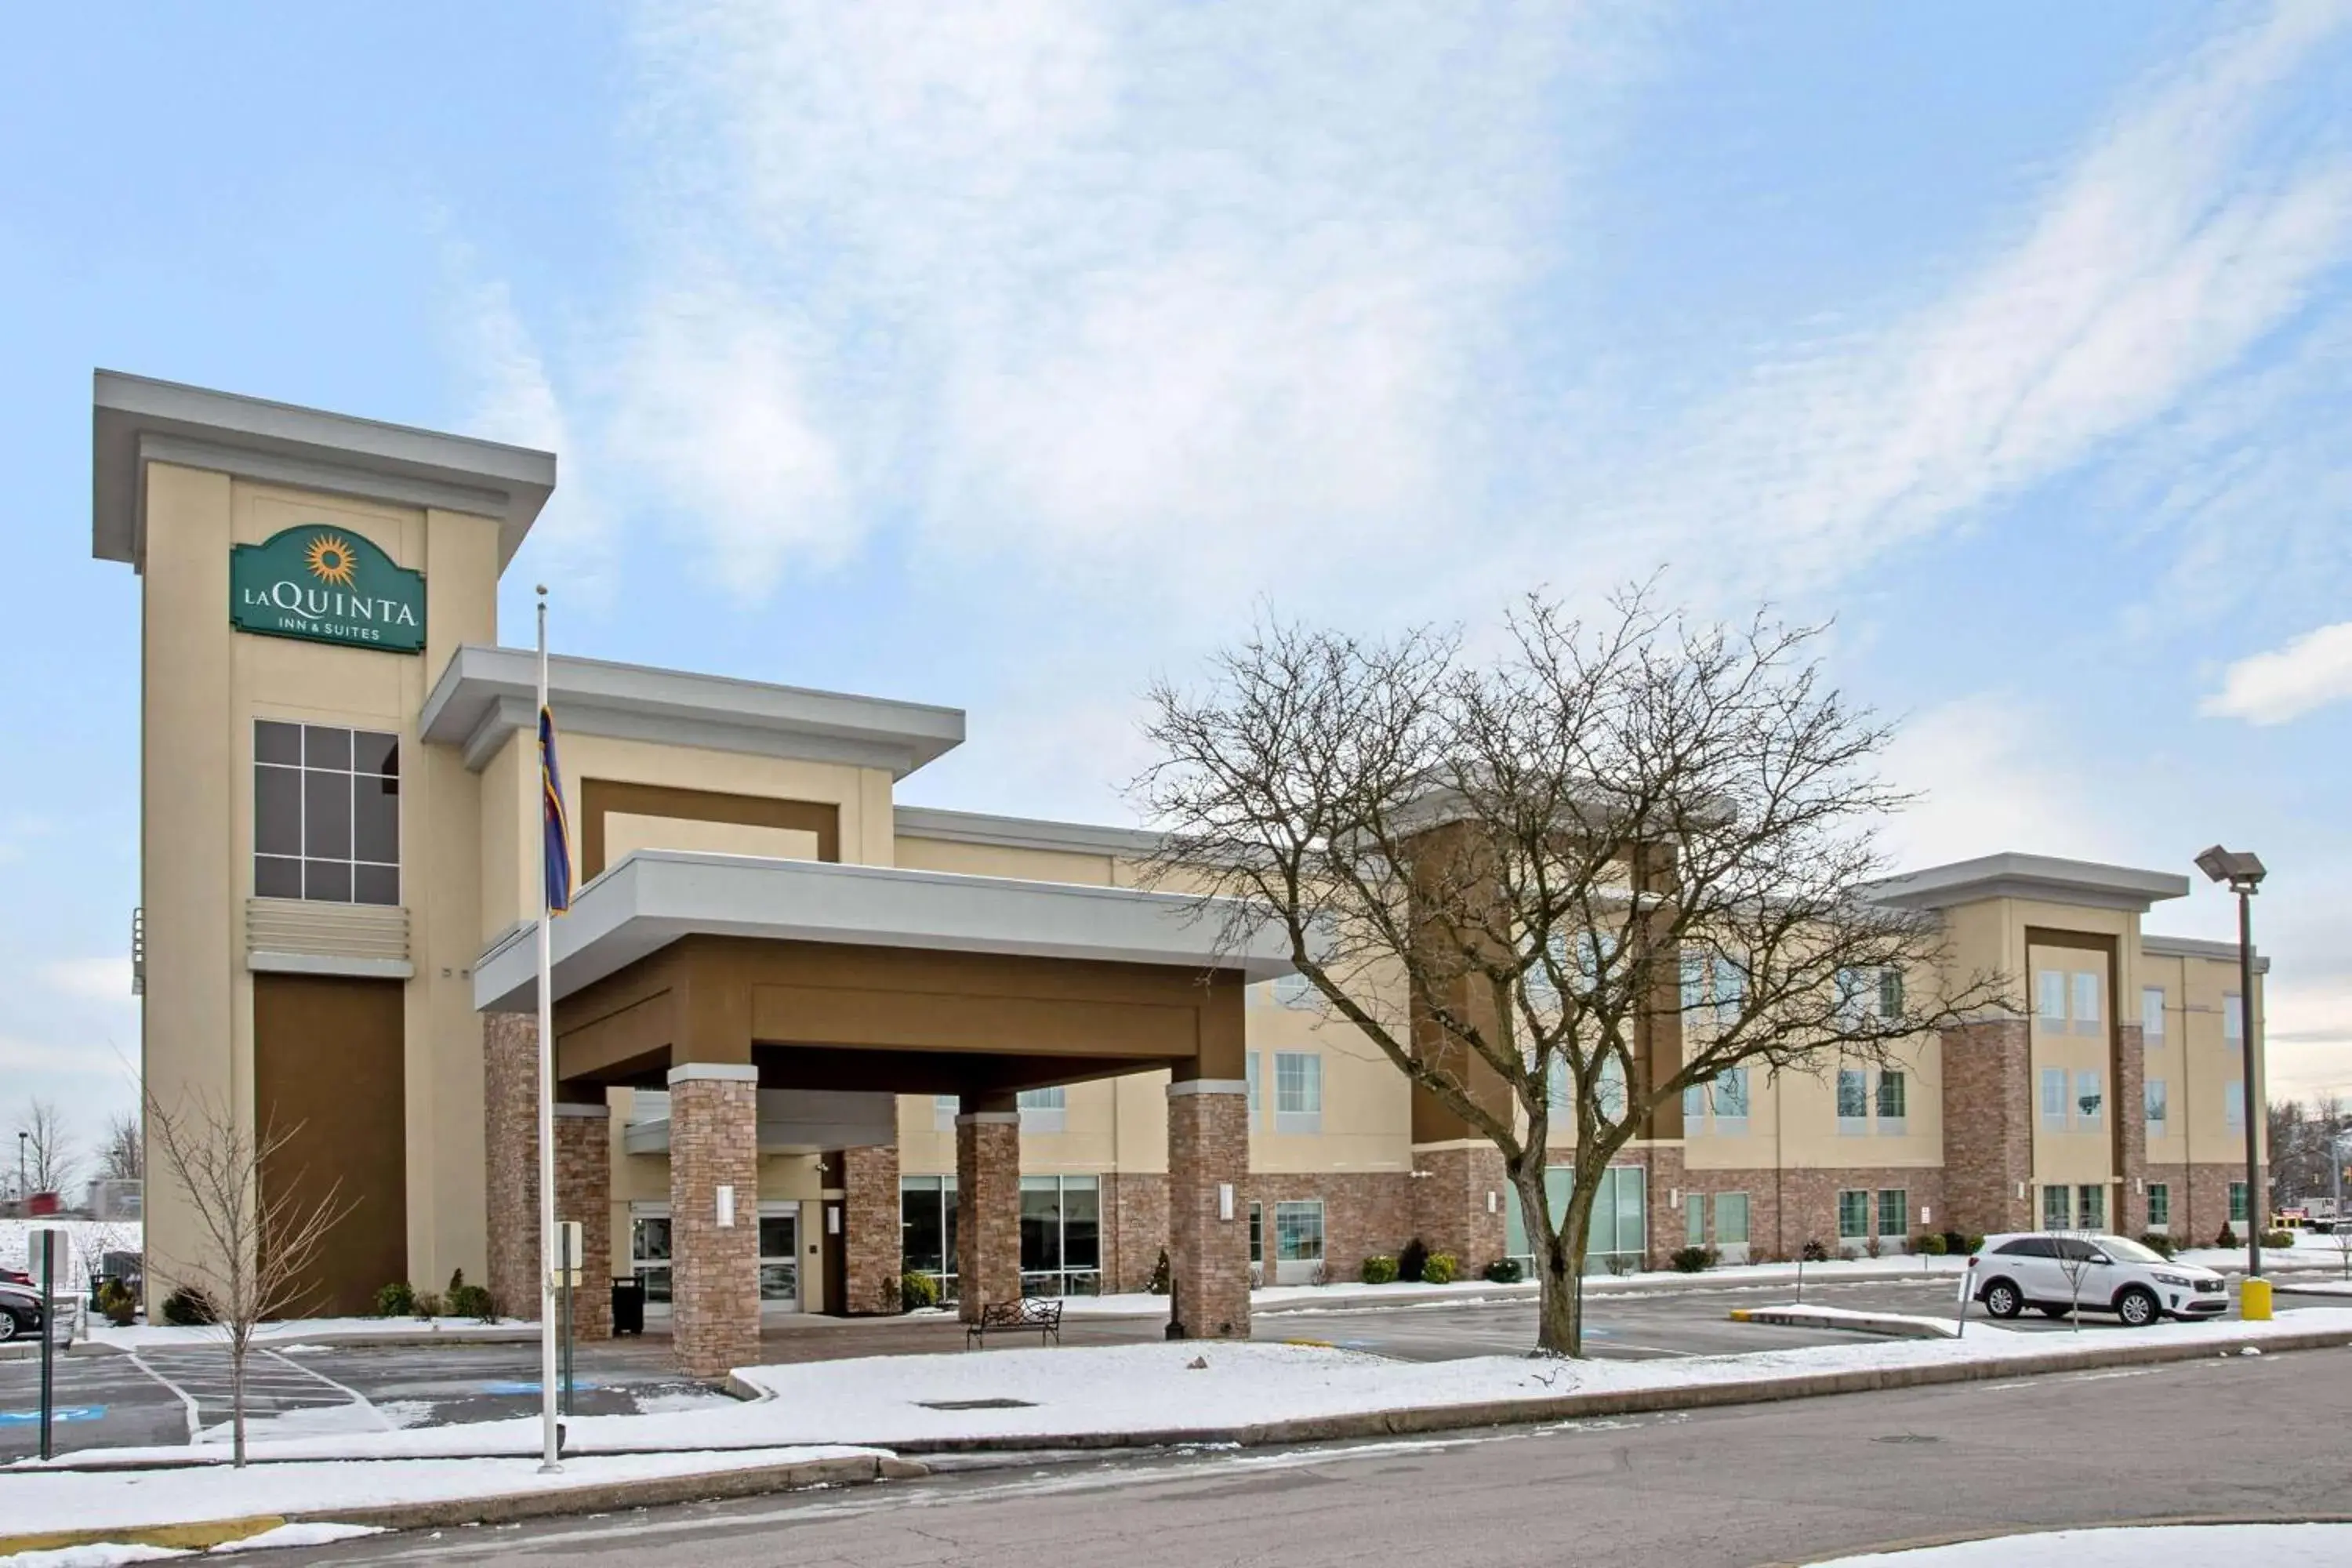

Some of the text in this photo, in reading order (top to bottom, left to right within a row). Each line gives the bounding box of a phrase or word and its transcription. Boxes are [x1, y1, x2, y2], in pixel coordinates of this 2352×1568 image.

[278, 617, 379, 641] INN & SUITES
